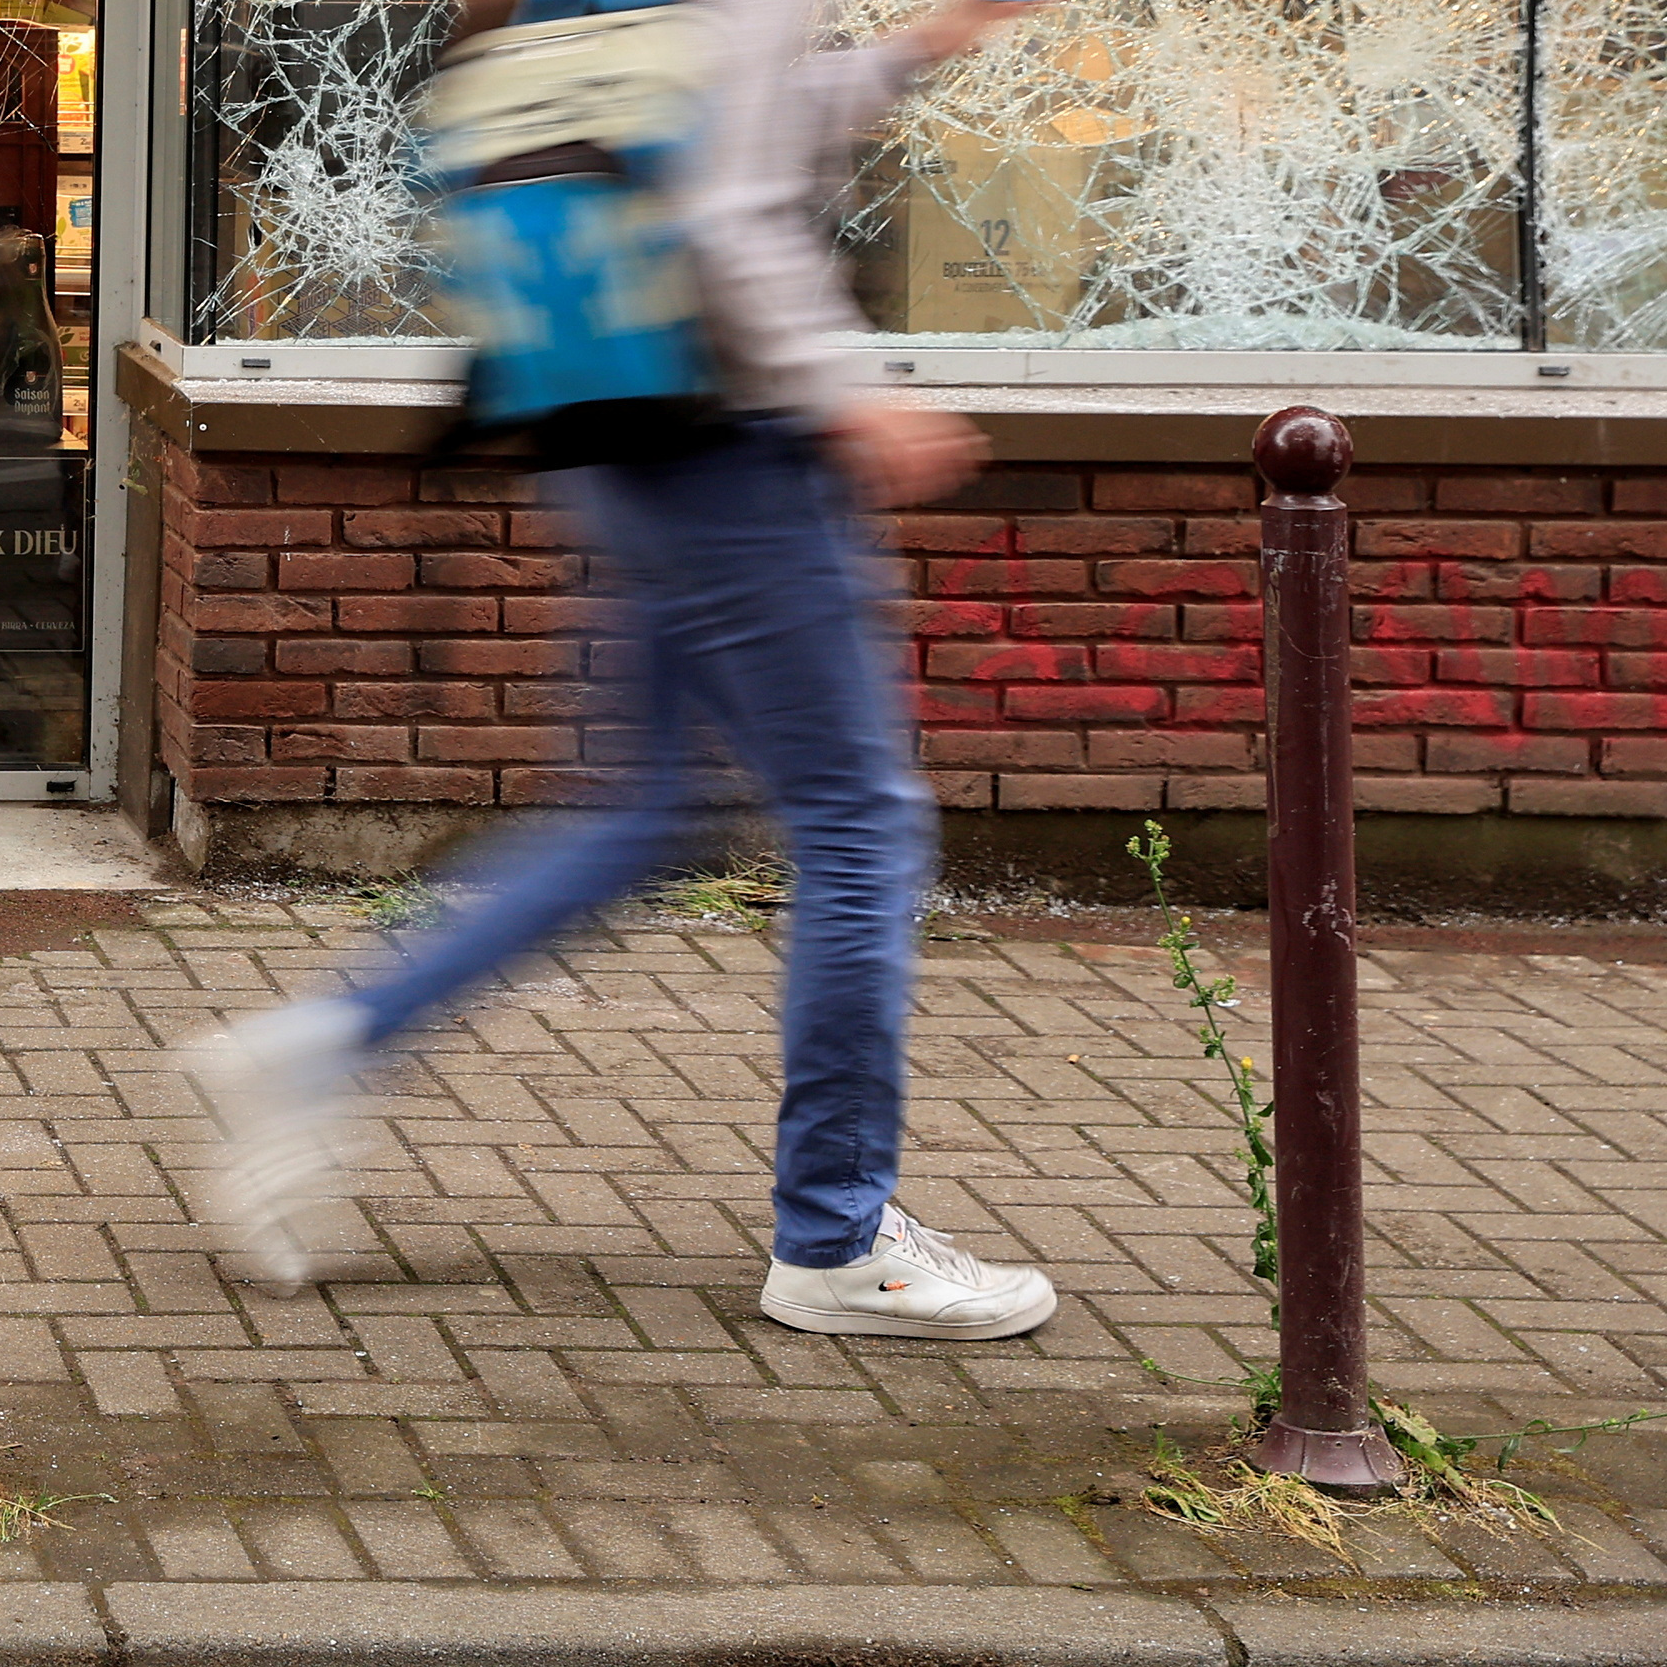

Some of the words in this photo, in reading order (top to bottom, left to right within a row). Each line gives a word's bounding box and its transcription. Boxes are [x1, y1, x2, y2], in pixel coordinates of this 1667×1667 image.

[981, 219, 1010, 257] 12
[14, 387, 50, 400] Saison
[14, 401, 51, 415] Dupont
[14, 530, 78, 555] DIEU
[35, 621, 75, 630] CERVEZA
